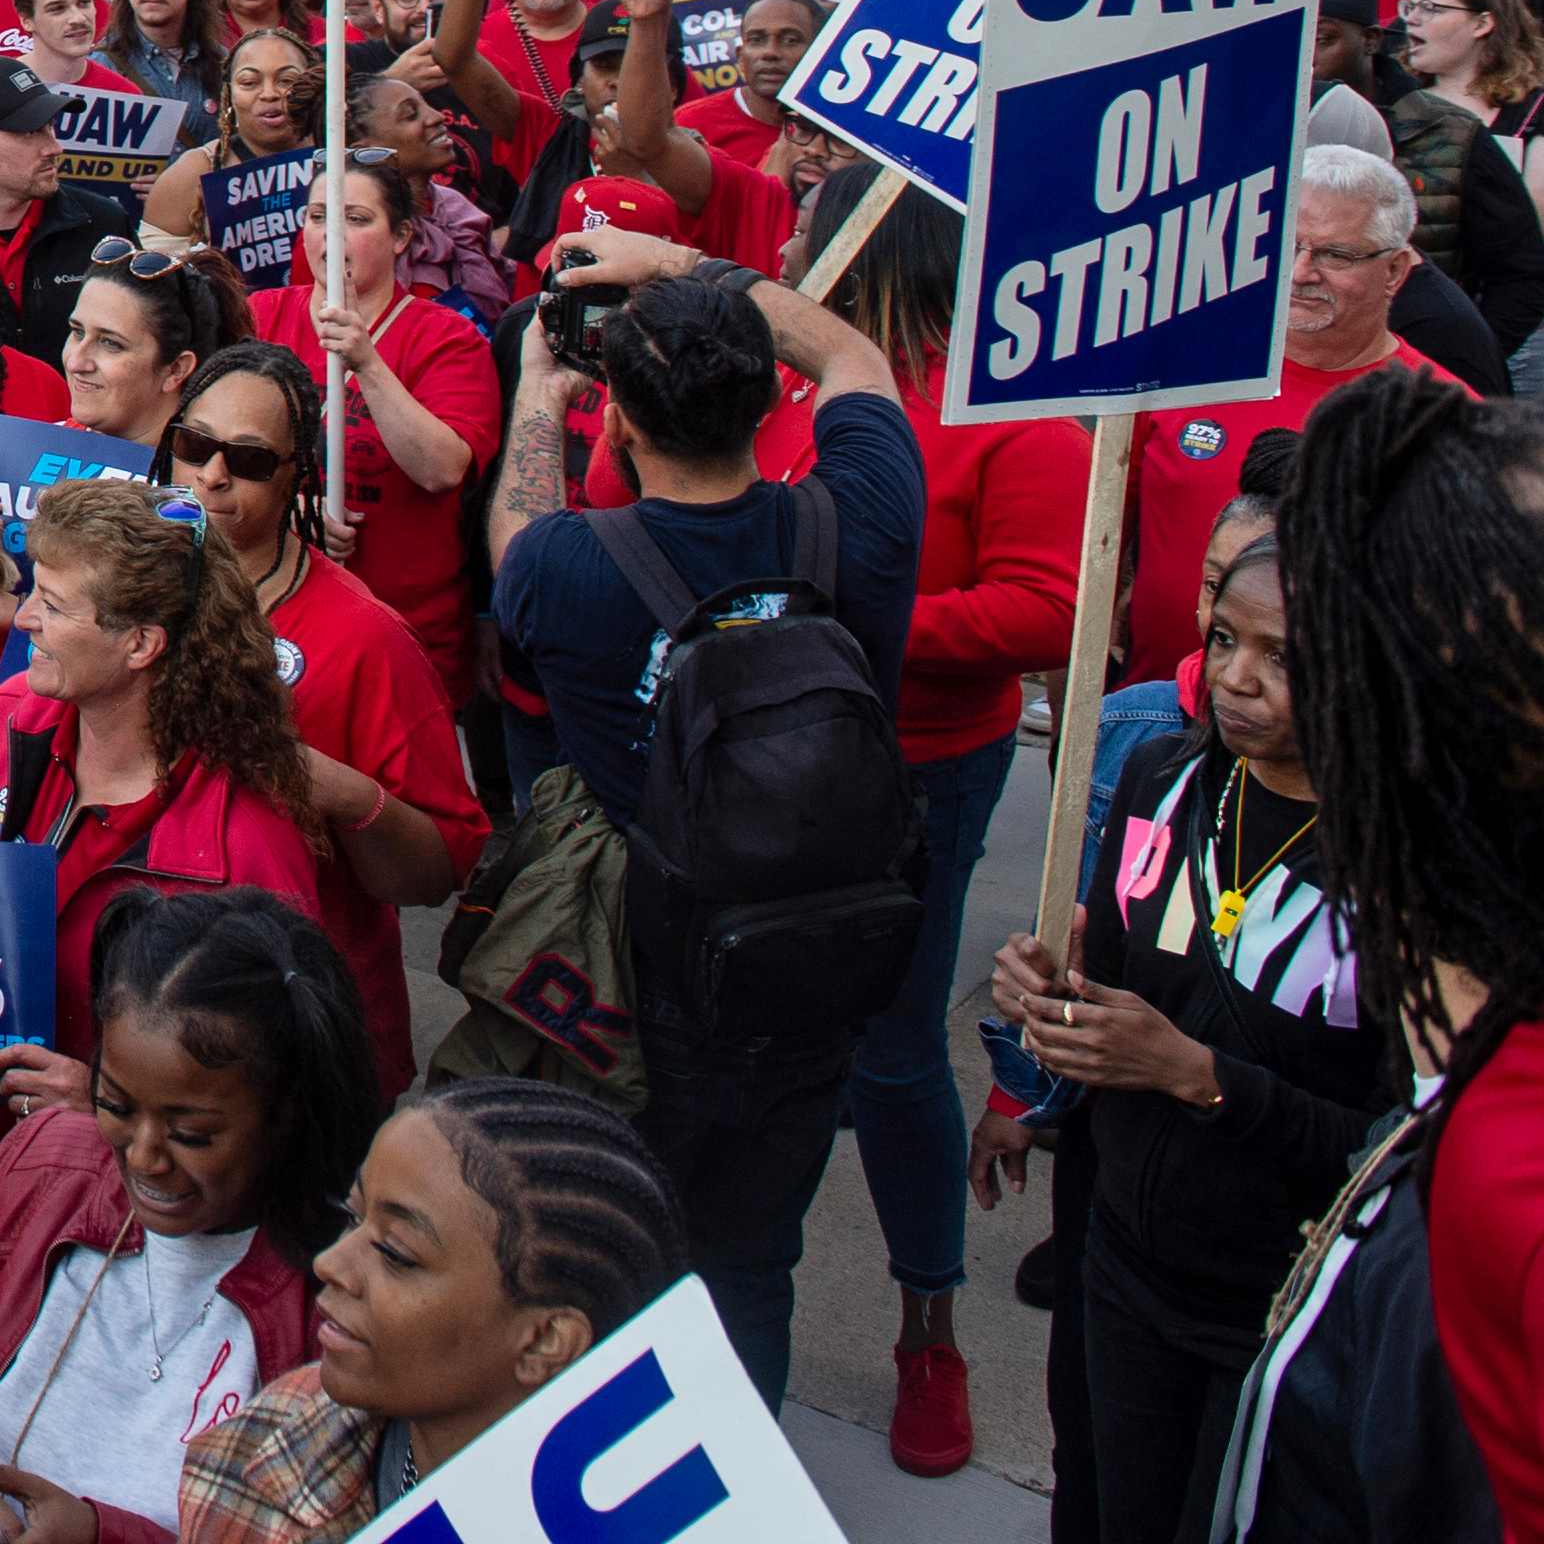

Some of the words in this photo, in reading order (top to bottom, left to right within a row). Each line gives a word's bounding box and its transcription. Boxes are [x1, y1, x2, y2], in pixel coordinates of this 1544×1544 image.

[54, 93, 160, 149] UAW
[1095, 64, 1205, 214] ON
[262, 192, 291, 210] THE
[989, 166, 1274, 381] STRIKE
[1188, 423, 1221, 439] 97%
